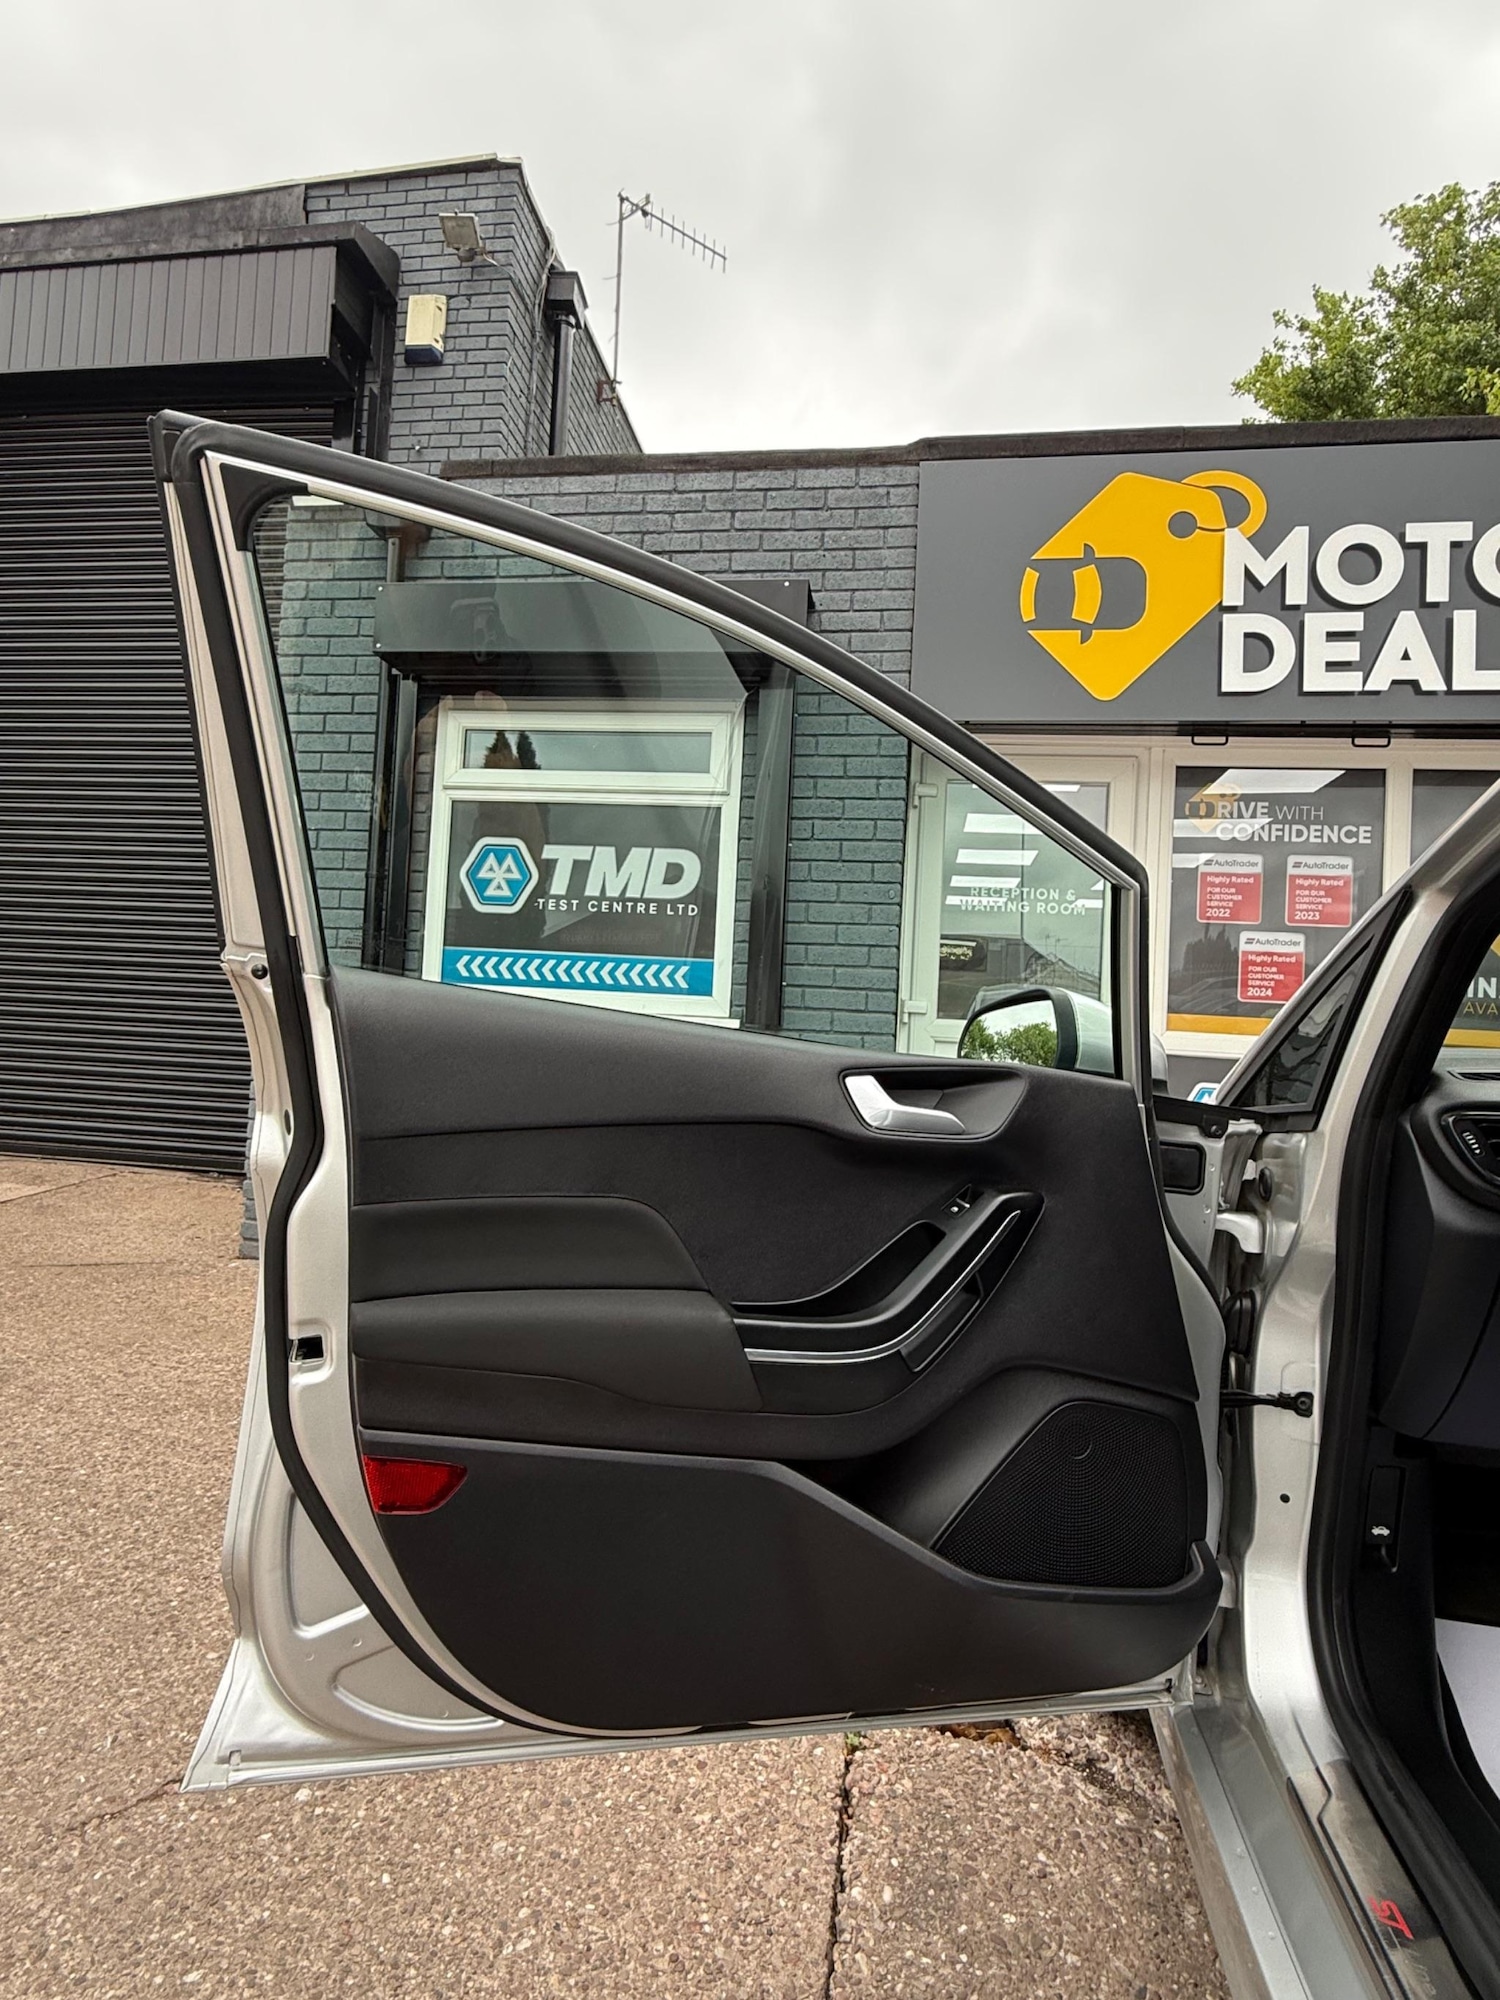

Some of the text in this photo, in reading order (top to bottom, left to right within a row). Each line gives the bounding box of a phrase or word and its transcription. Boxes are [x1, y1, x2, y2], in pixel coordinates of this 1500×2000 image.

[1221, 609, 1500, 692] DEAL
[1275, 805, 1324, 821] WITH
[1216, 823, 1372, 844] CONFIDENCE
[1213, 859, 1259, 868] AutoTrader
[1302, 861, 1349, 870] AutoTrader
[541, 844, 701, 899] TMD
[1207, 875, 1254, 884] Highly Rated
[1295, 878, 1344, 887] Highly Rated
[970, 886, 1076, 901] RECEPTION &
[537, 898, 698, 916] TEST CENTRE LTD
[960, 899, 1086, 916] WAITING ROOM
[1206, 908, 1231, 917] 2022
[1294, 911, 1320, 920] 2023
[1254, 938, 1301, 947] AutoTrader
[1248, 954, 1296, 963] Highly Rated
[1467, 976, 1500, 999] IN
[1247, 988, 1273, 997] 2024
